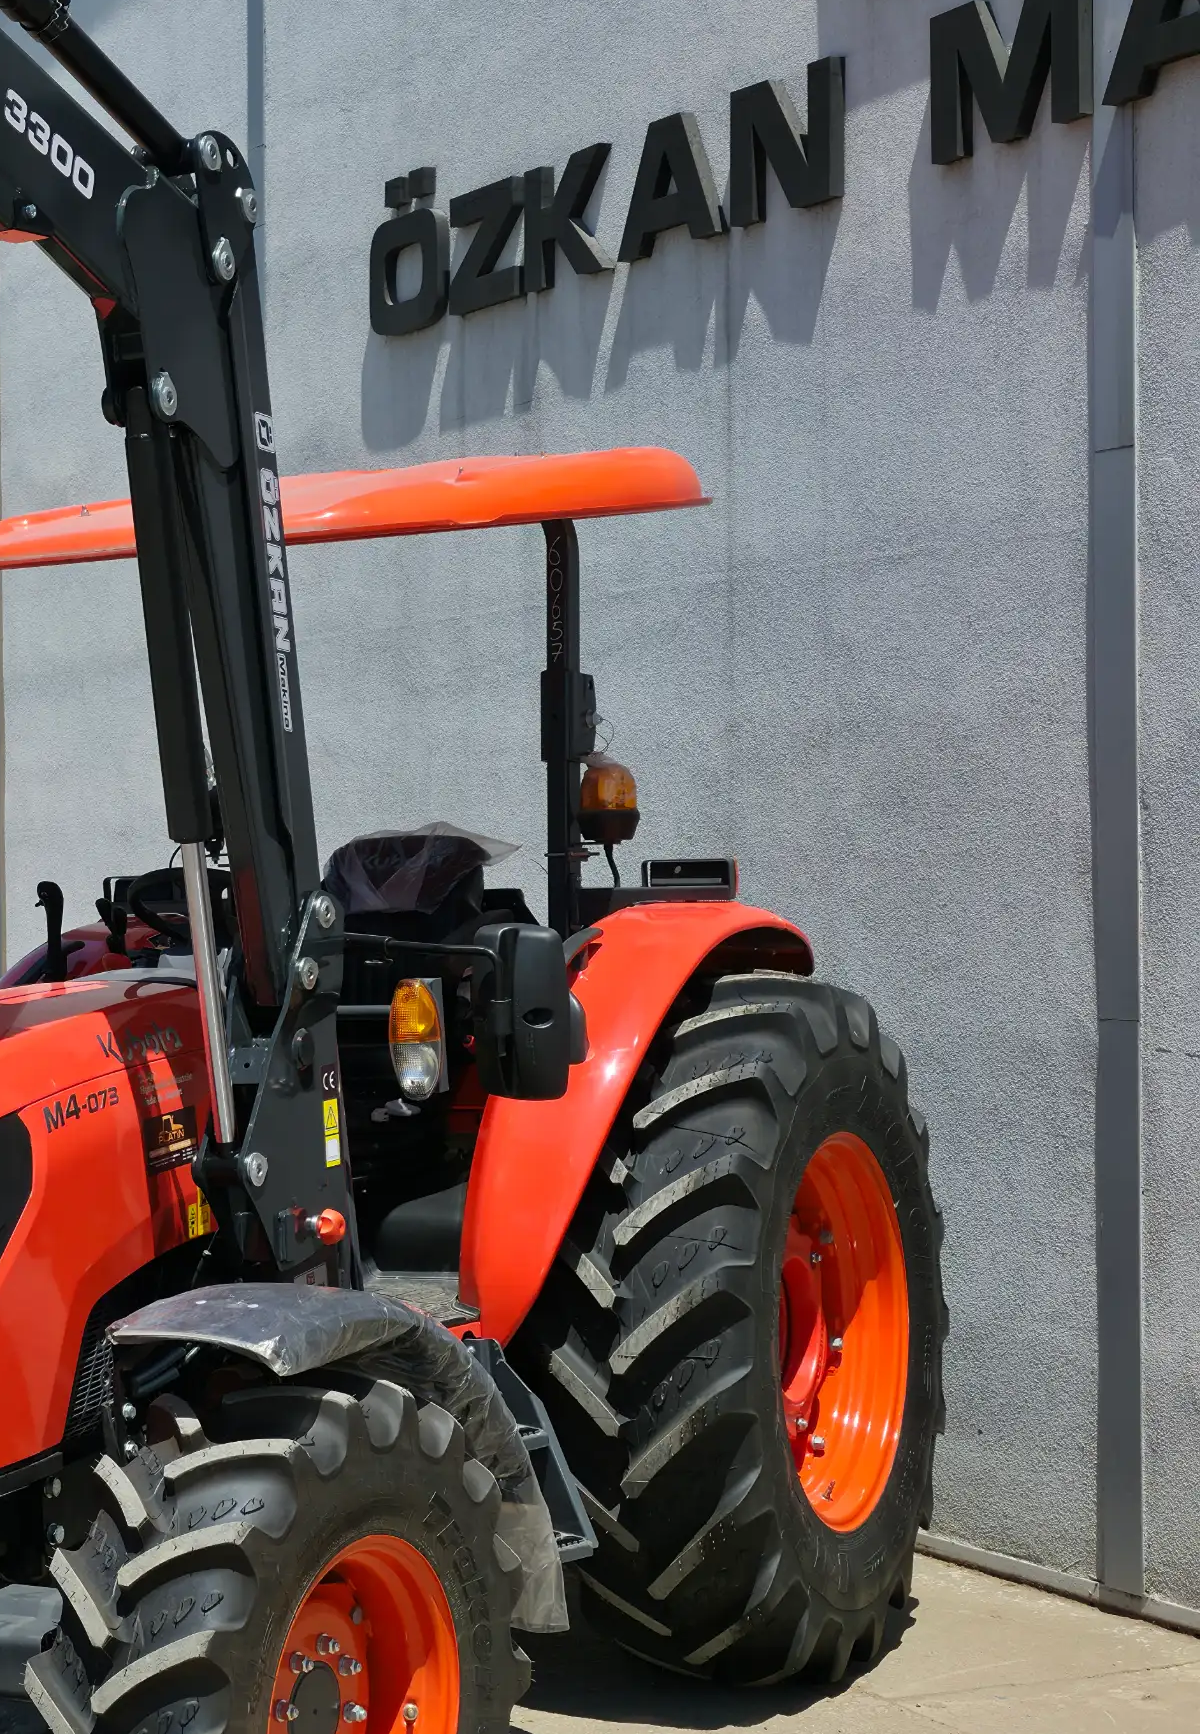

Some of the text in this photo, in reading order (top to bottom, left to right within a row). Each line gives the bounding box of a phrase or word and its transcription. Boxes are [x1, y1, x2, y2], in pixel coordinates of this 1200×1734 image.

[3, 87, 96, 200] 3300
[369, 57, 846, 337] ÖZKAN
[259, 467, 293, 731] ÖZKAN Makina
[42, 1087, 119, 1134] M4-073
